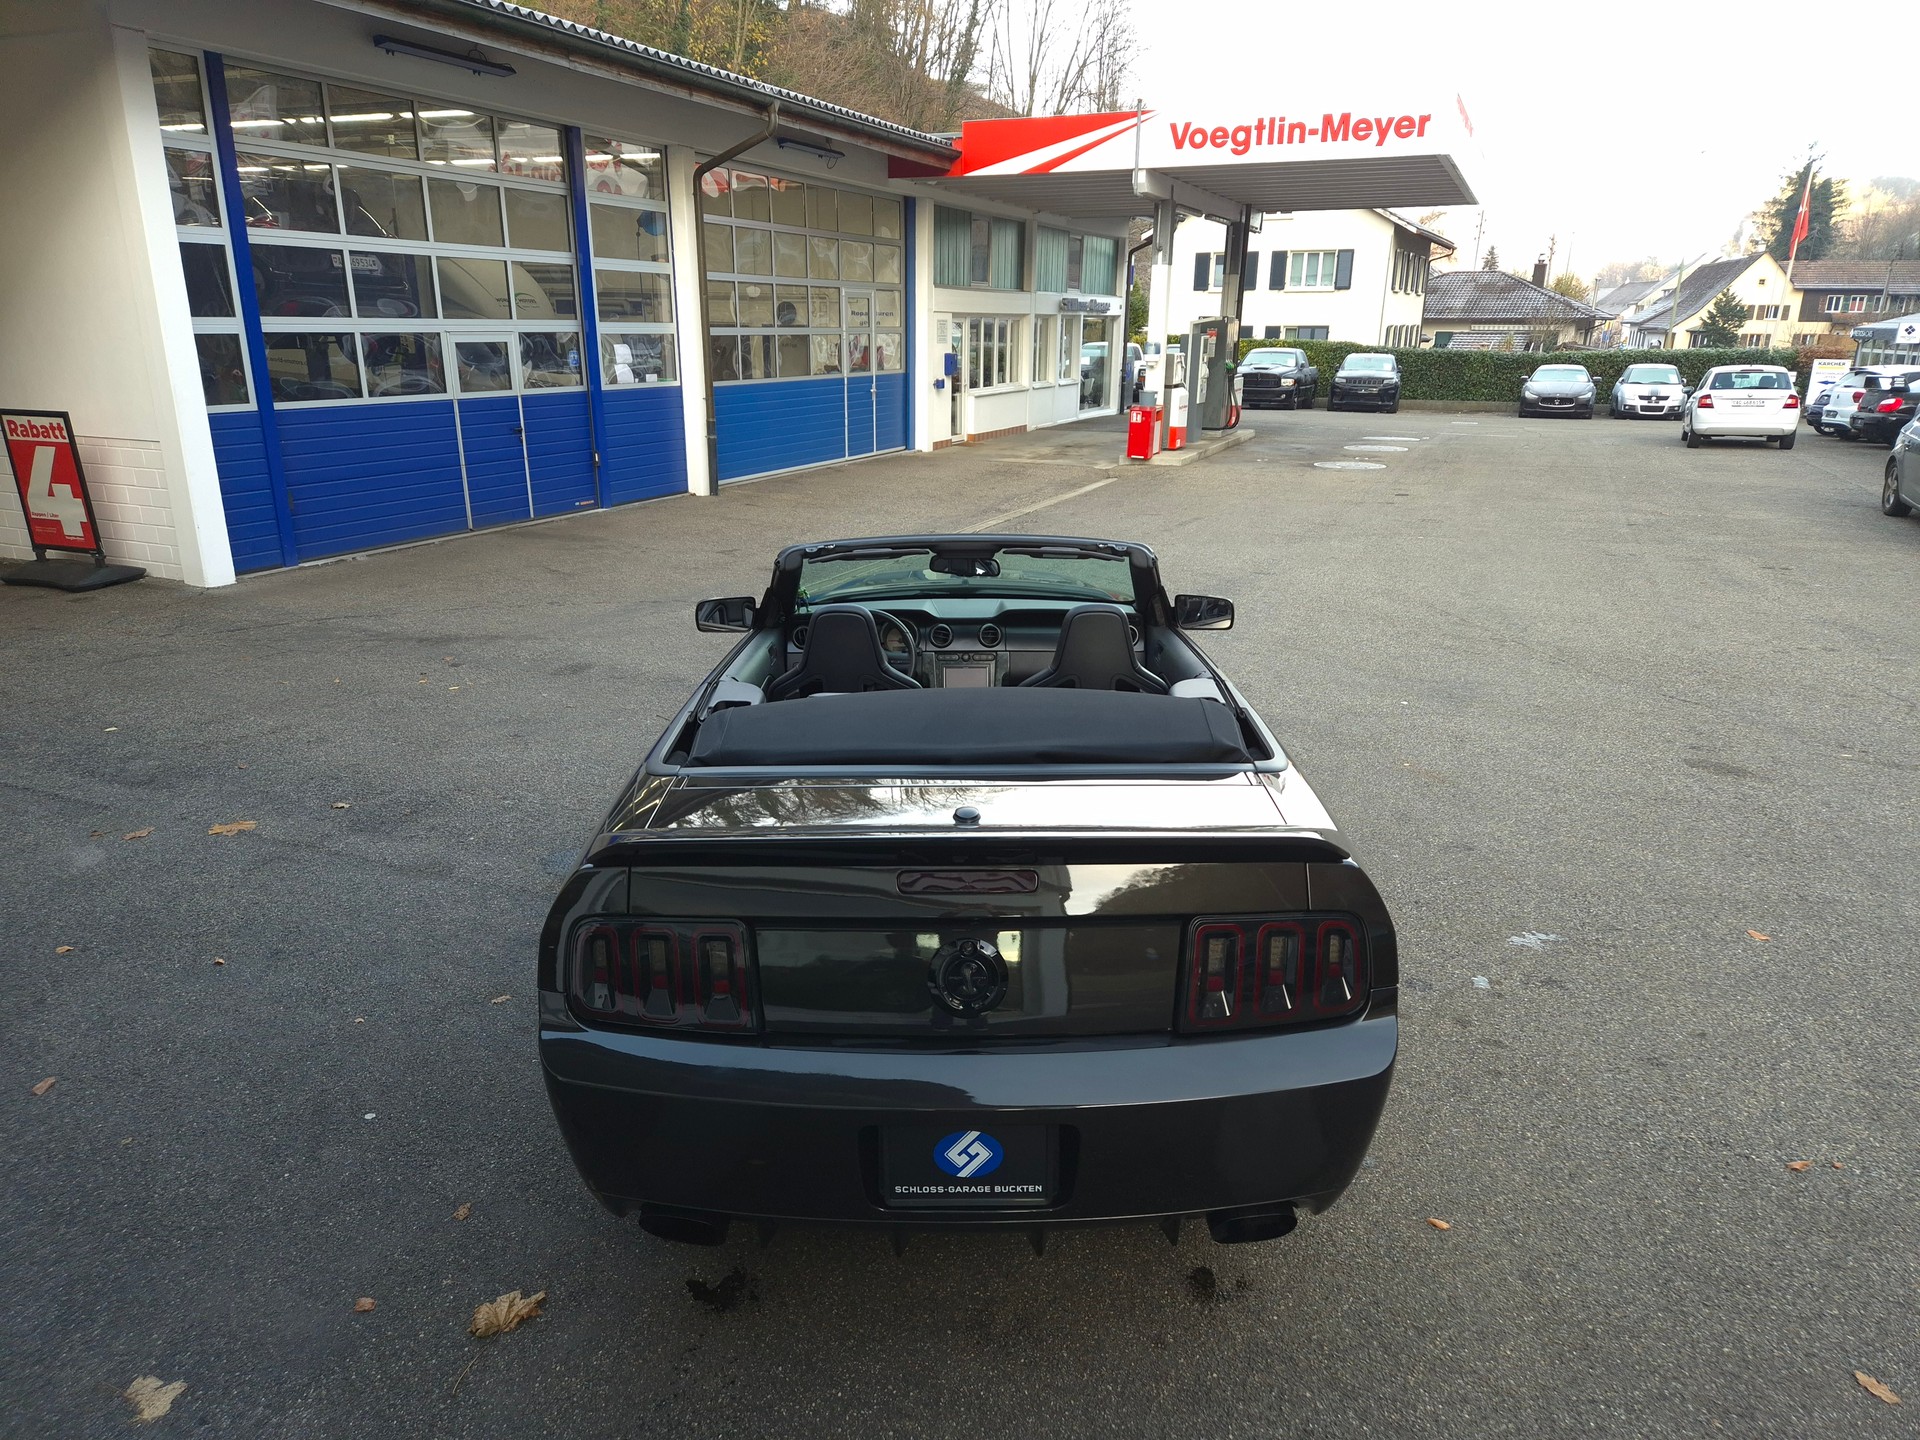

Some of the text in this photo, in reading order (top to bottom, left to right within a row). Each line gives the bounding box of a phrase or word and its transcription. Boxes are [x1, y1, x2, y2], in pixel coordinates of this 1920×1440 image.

[1169, 112, 1432, 156] Voegtlin-Meyer
[6, 419, 67, 440] Rabatt
[27, 445, 87, 537] 4
[894, 1185, 1042, 1193] SCHLOSS-GARAGE BUCKTEN
